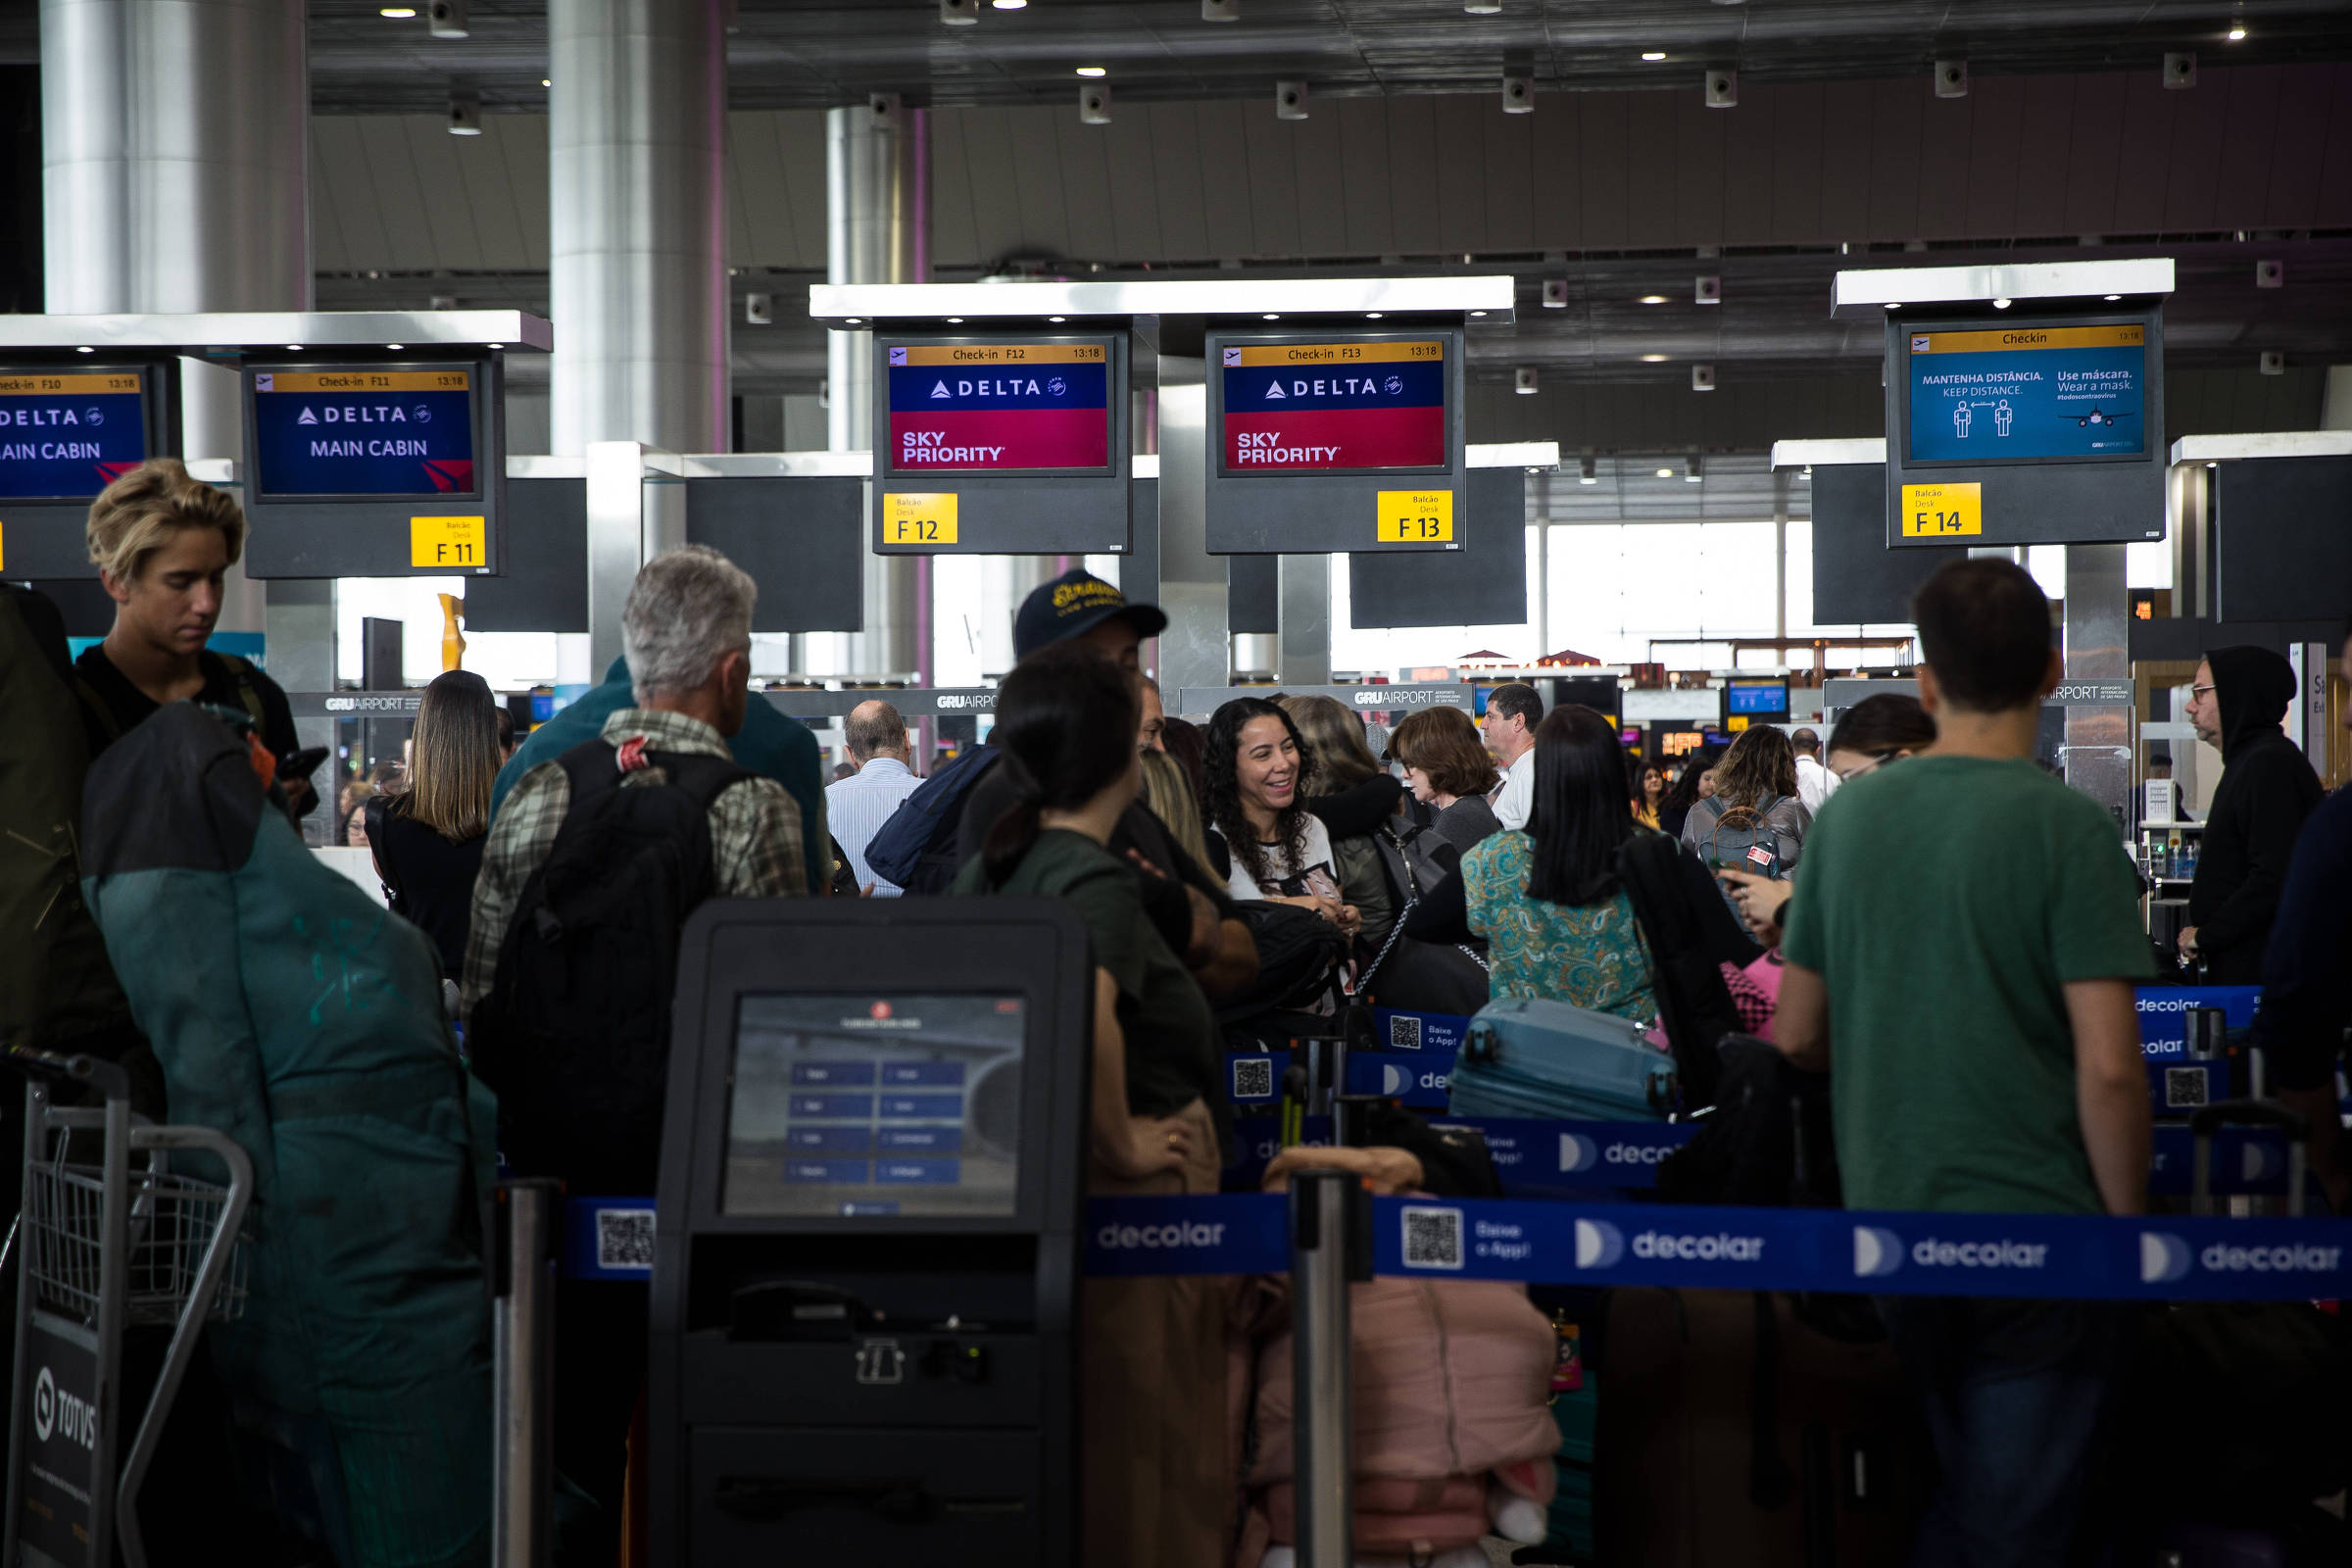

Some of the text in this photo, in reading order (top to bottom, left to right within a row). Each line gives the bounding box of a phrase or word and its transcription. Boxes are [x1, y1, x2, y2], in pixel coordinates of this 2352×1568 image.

[2002, 331, 2140, 346] Checkin 13:18
[953, 348, 1100, 361] Check-in F12 13:18
[1288, 345, 1438, 361] Check-in F13 13:18
[318, 375, 465, 387] Check-in F11 13:18
[1922, 370, 2044, 386] MANTENHA DISTÂNCIA.
[2057, 368, 2132, 381] Use máscara.
[41, 379, 62, 390] F10
[109, 379, 136, 389] 13:18
[958, 378, 1041, 397] DELTA
[1293, 377, 1378, 397] DELTA
[1943, 384, 2024, 398] KEEP DISTANCE.
[2057, 379, 2134, 393] Wear a mask.
[0, 409, 79, 426] DELTA
[323, 406, 408, 423] DELTA
[903, 431, 946, 448] SKY
[1237, 431, 1282, 449] SKY
[0, 442, 102, 461] AIN CABIN
[310, 440, 428, 458] MAIN CABIN
[903, 447, 1003, 464] PRIORITY
[1237, 446, 1341, 465] PRIORITY
[1915, 489, 1943, 498] Balcão
[896, 498, 922, 507] Balcão
[1915, 500, 1935, 509] Desk
[898, 519, 939, 540] F 12
[1399, 516, 1441, 538] F 13
[1916, 511, 1963, 533] F 14
[437, 543, 472, 564] F 11
[324, 697, 405, 711] GRUAIRPORT
[937, 694, 999, 710] GRUAIRPO
[1354, 690, 1435, 705] GRUAIRPORT
[2134, 998, 2202, 1013] decolar
[1427, 1035, 1457, 1048] o App!
[2140, 1038, 2185, 1056] olar
[1098, 1218, 1227, 1250] decolar
[1631, 1227, 1764, 1261] decolar
[1911, 1236, 2050, 1269] decolar
[2200, 1242, 2343, 1272] decolar
[57, 1387, 96, 1450] TOTVS
